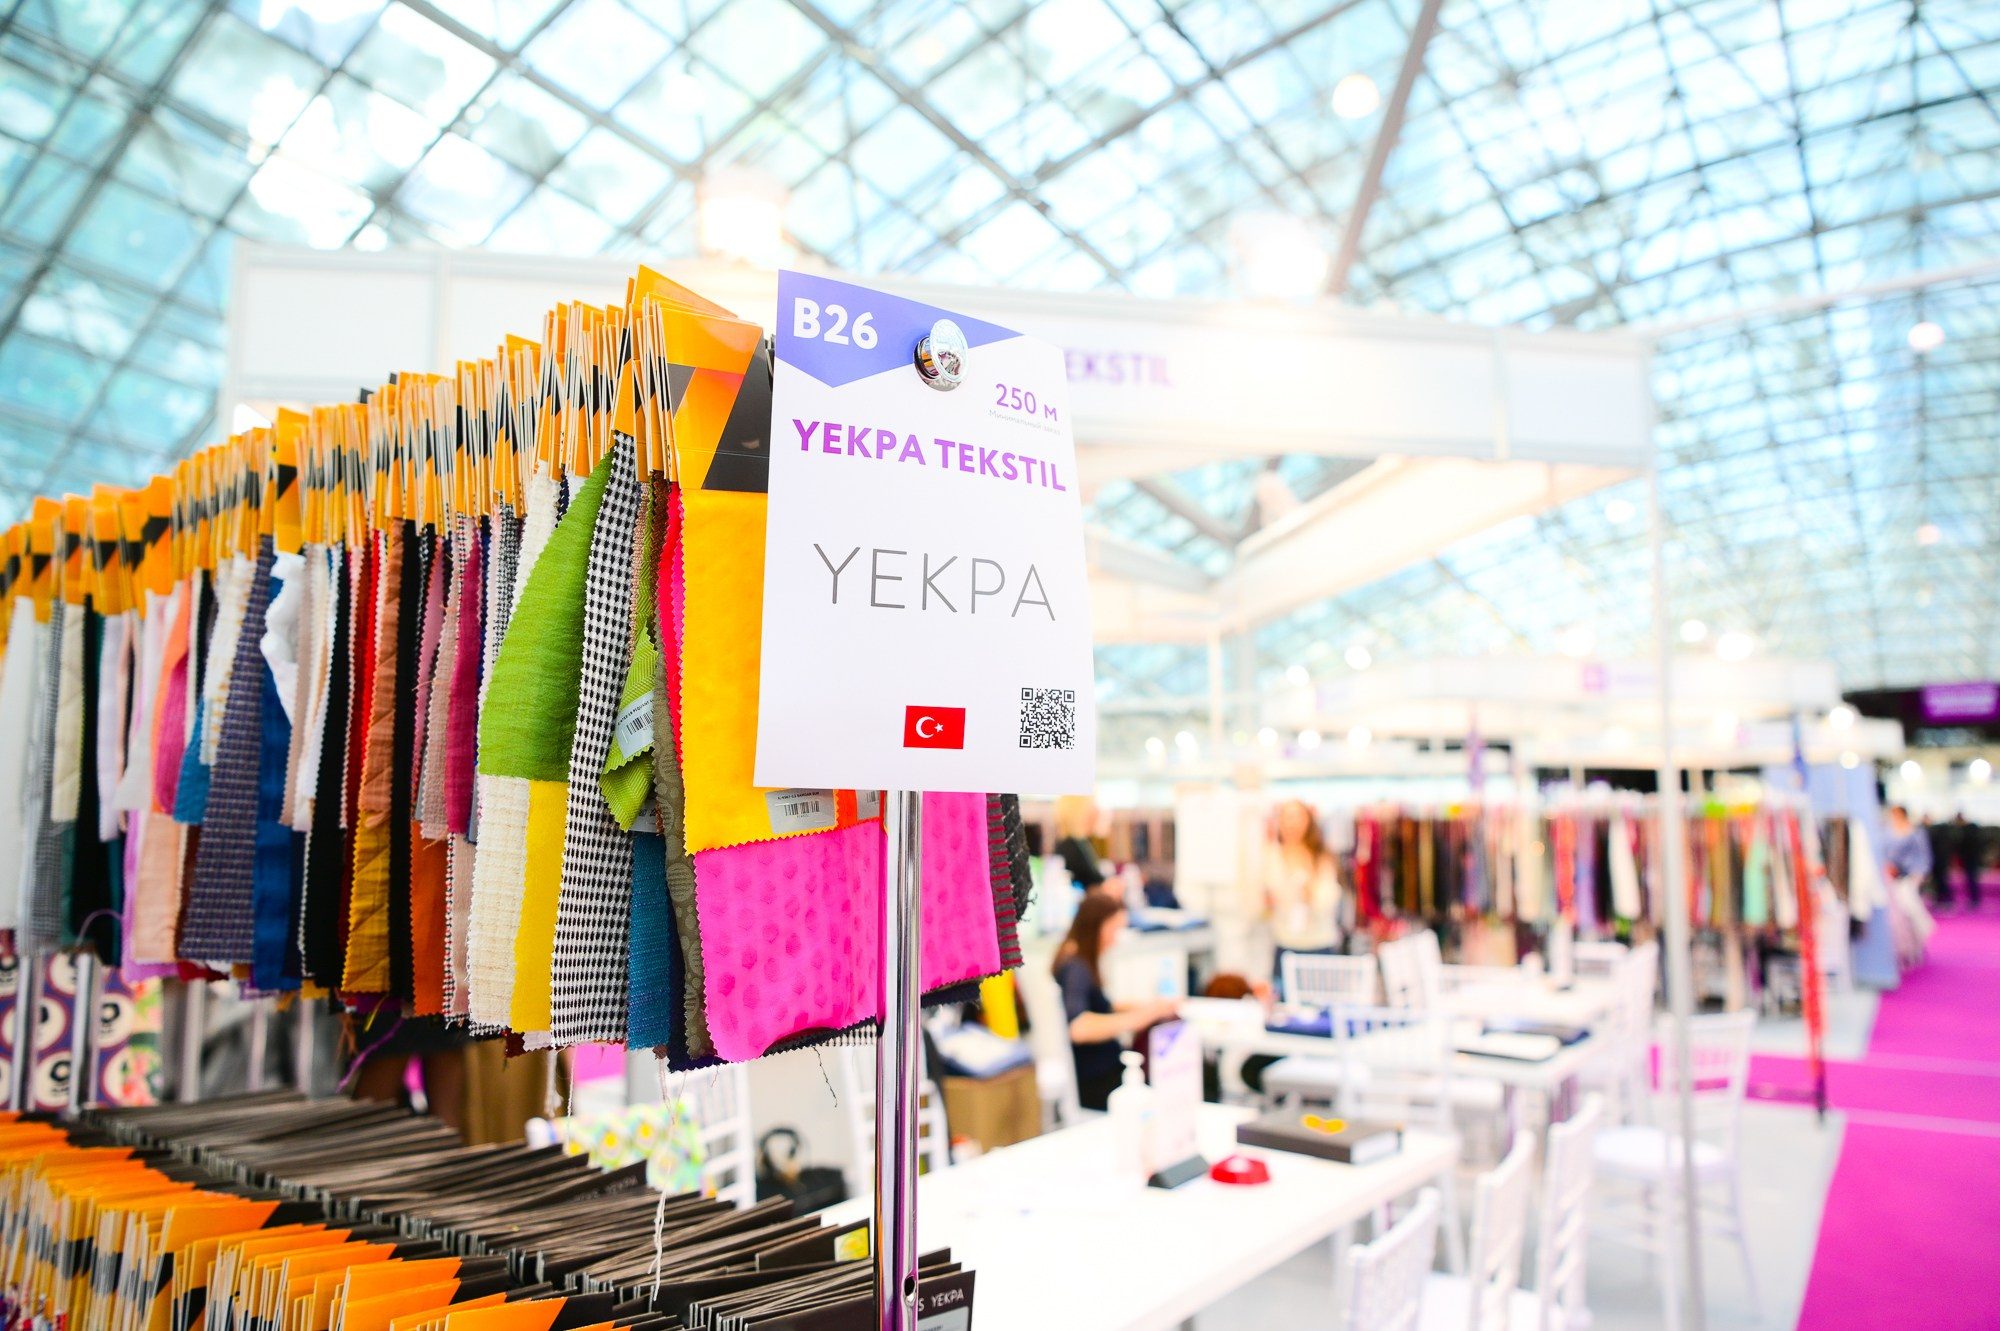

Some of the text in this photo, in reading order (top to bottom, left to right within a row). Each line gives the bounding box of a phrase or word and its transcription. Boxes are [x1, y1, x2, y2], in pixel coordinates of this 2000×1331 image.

[793, 297, 878, 350] B26
[1064, 349, 1174, 386] EKSTIL
[995, 383, 1036, 414] 250
[792, 419, 1066, 492] YEKPA TEKSTIL
[813, 543, 1056, 621] YEKPA
[931, 1288, 965, 1308] YEKPA
